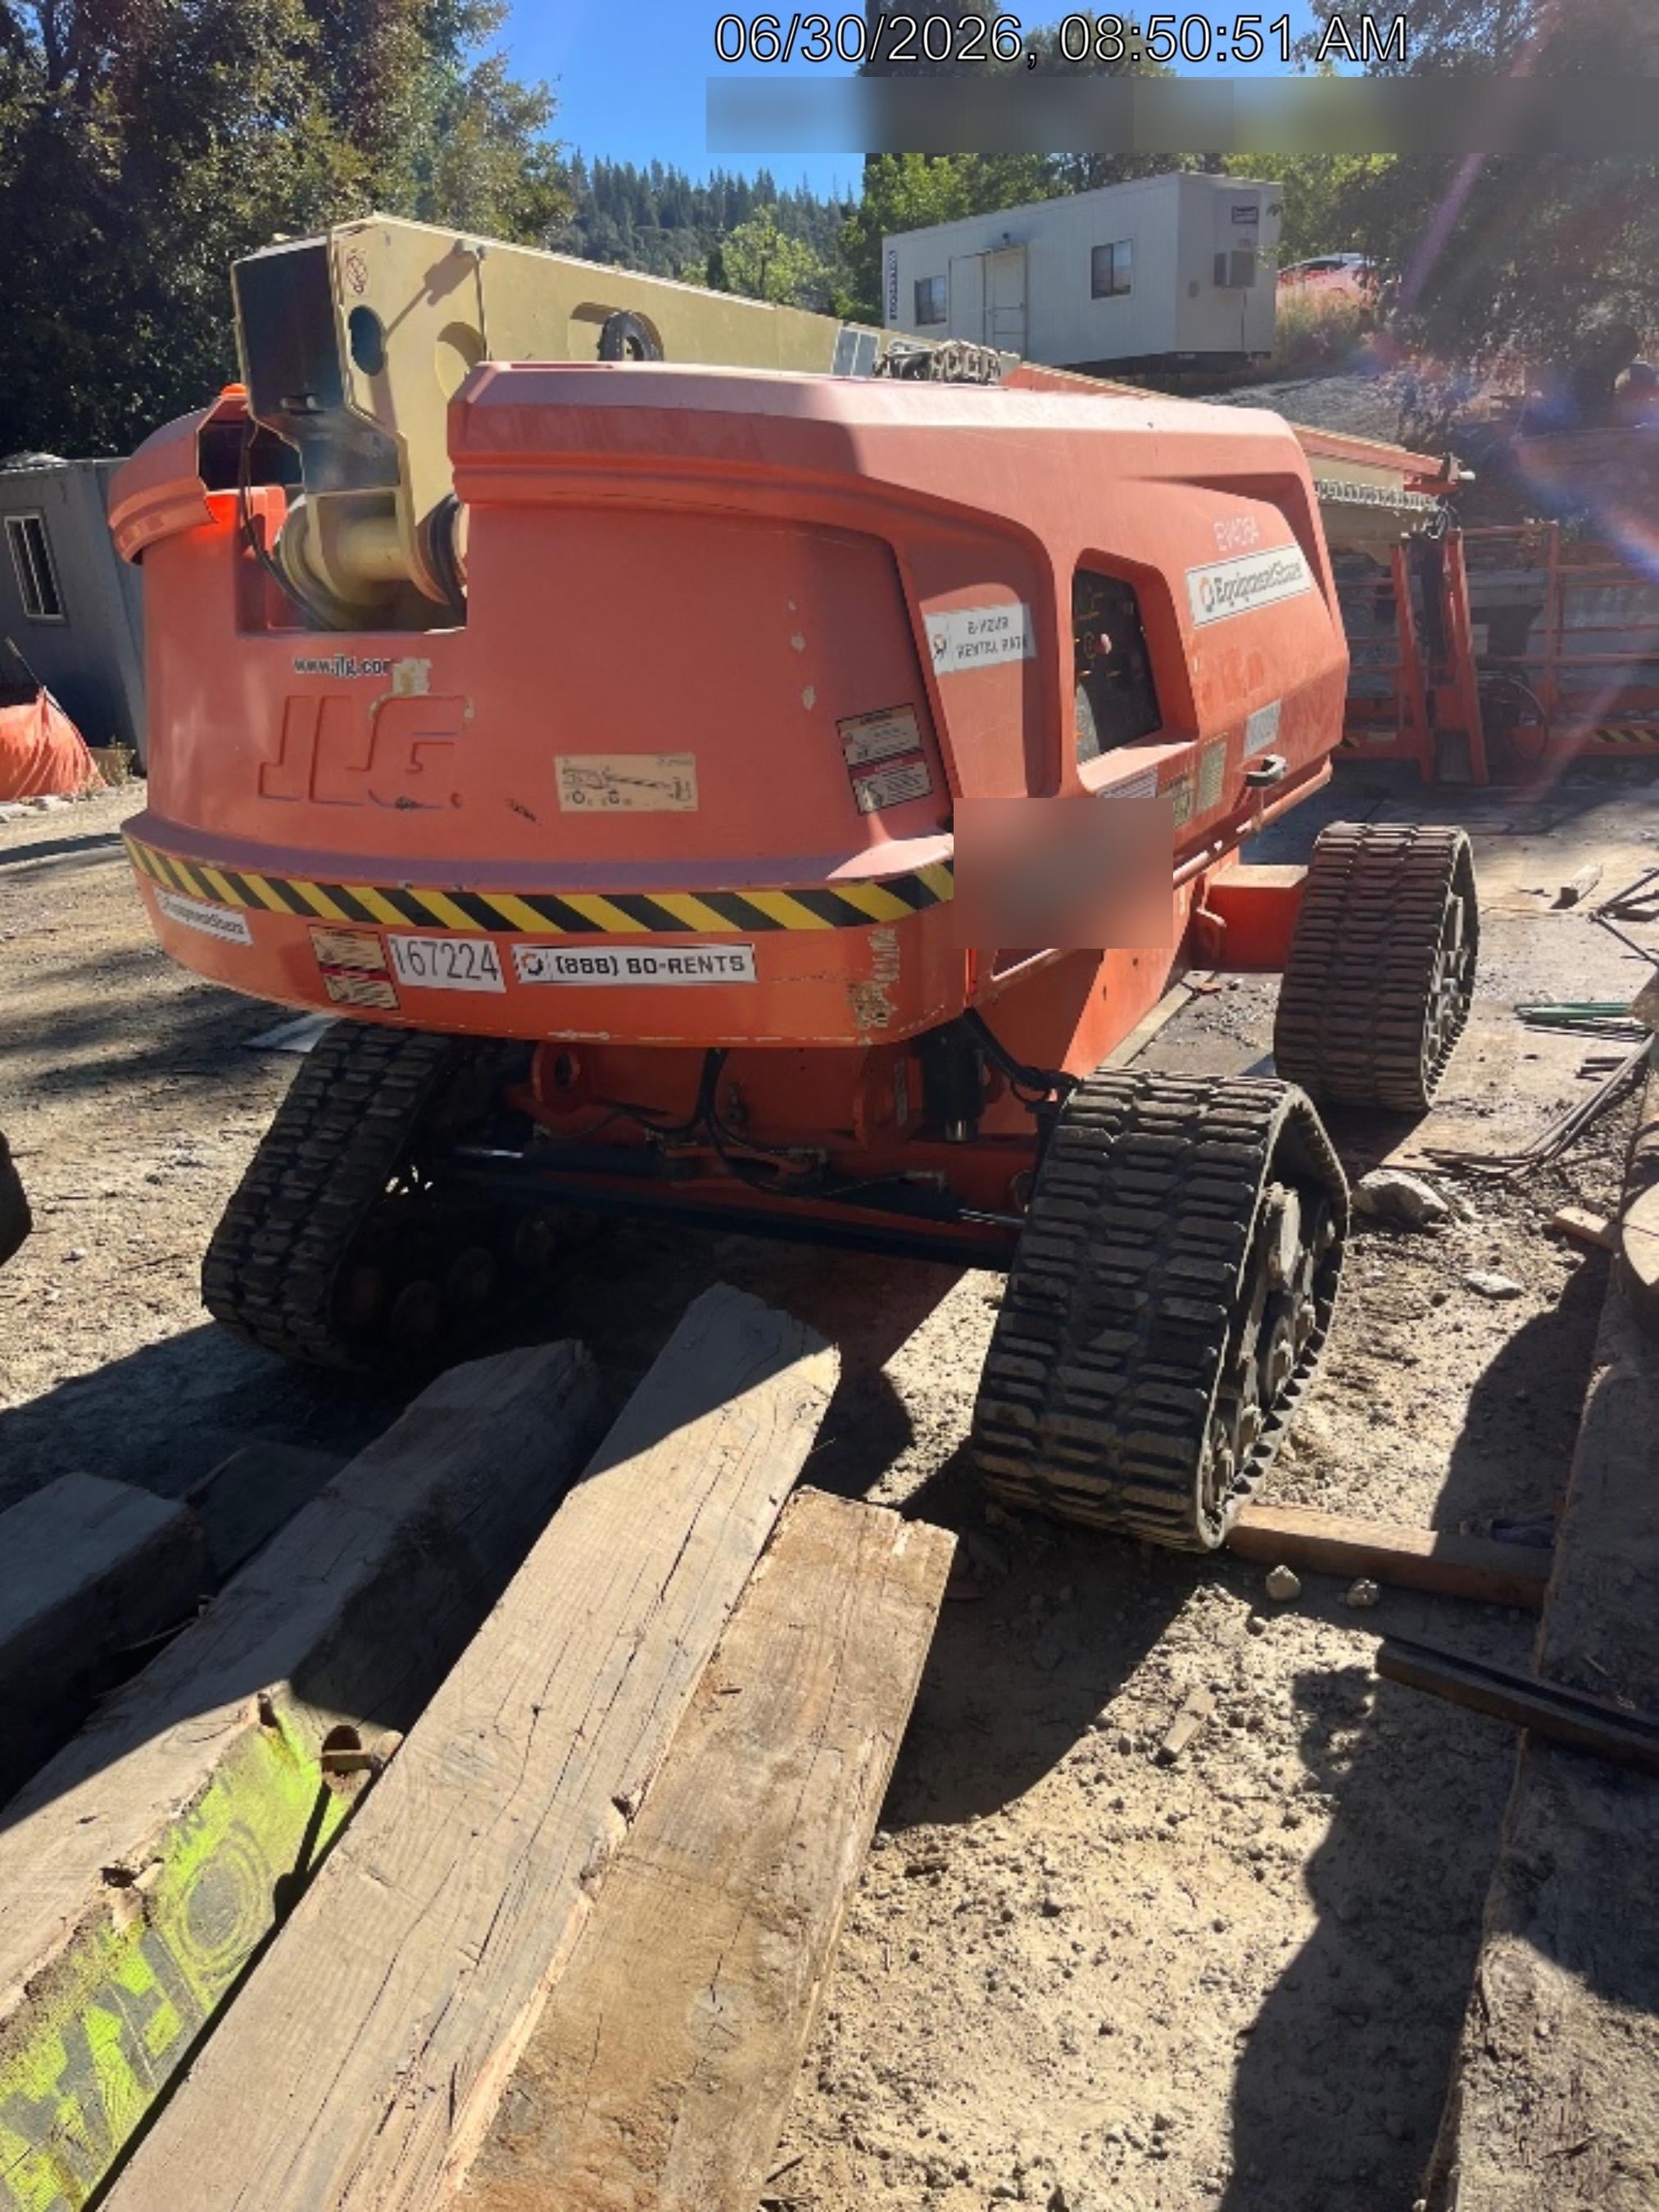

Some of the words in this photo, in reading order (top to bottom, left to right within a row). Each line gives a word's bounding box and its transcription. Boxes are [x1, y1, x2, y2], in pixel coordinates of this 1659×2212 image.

[258, 695, 467, 808] JLG
[389, 936, 497, 982] 167224
[556, 955, 620, 977] (888)
